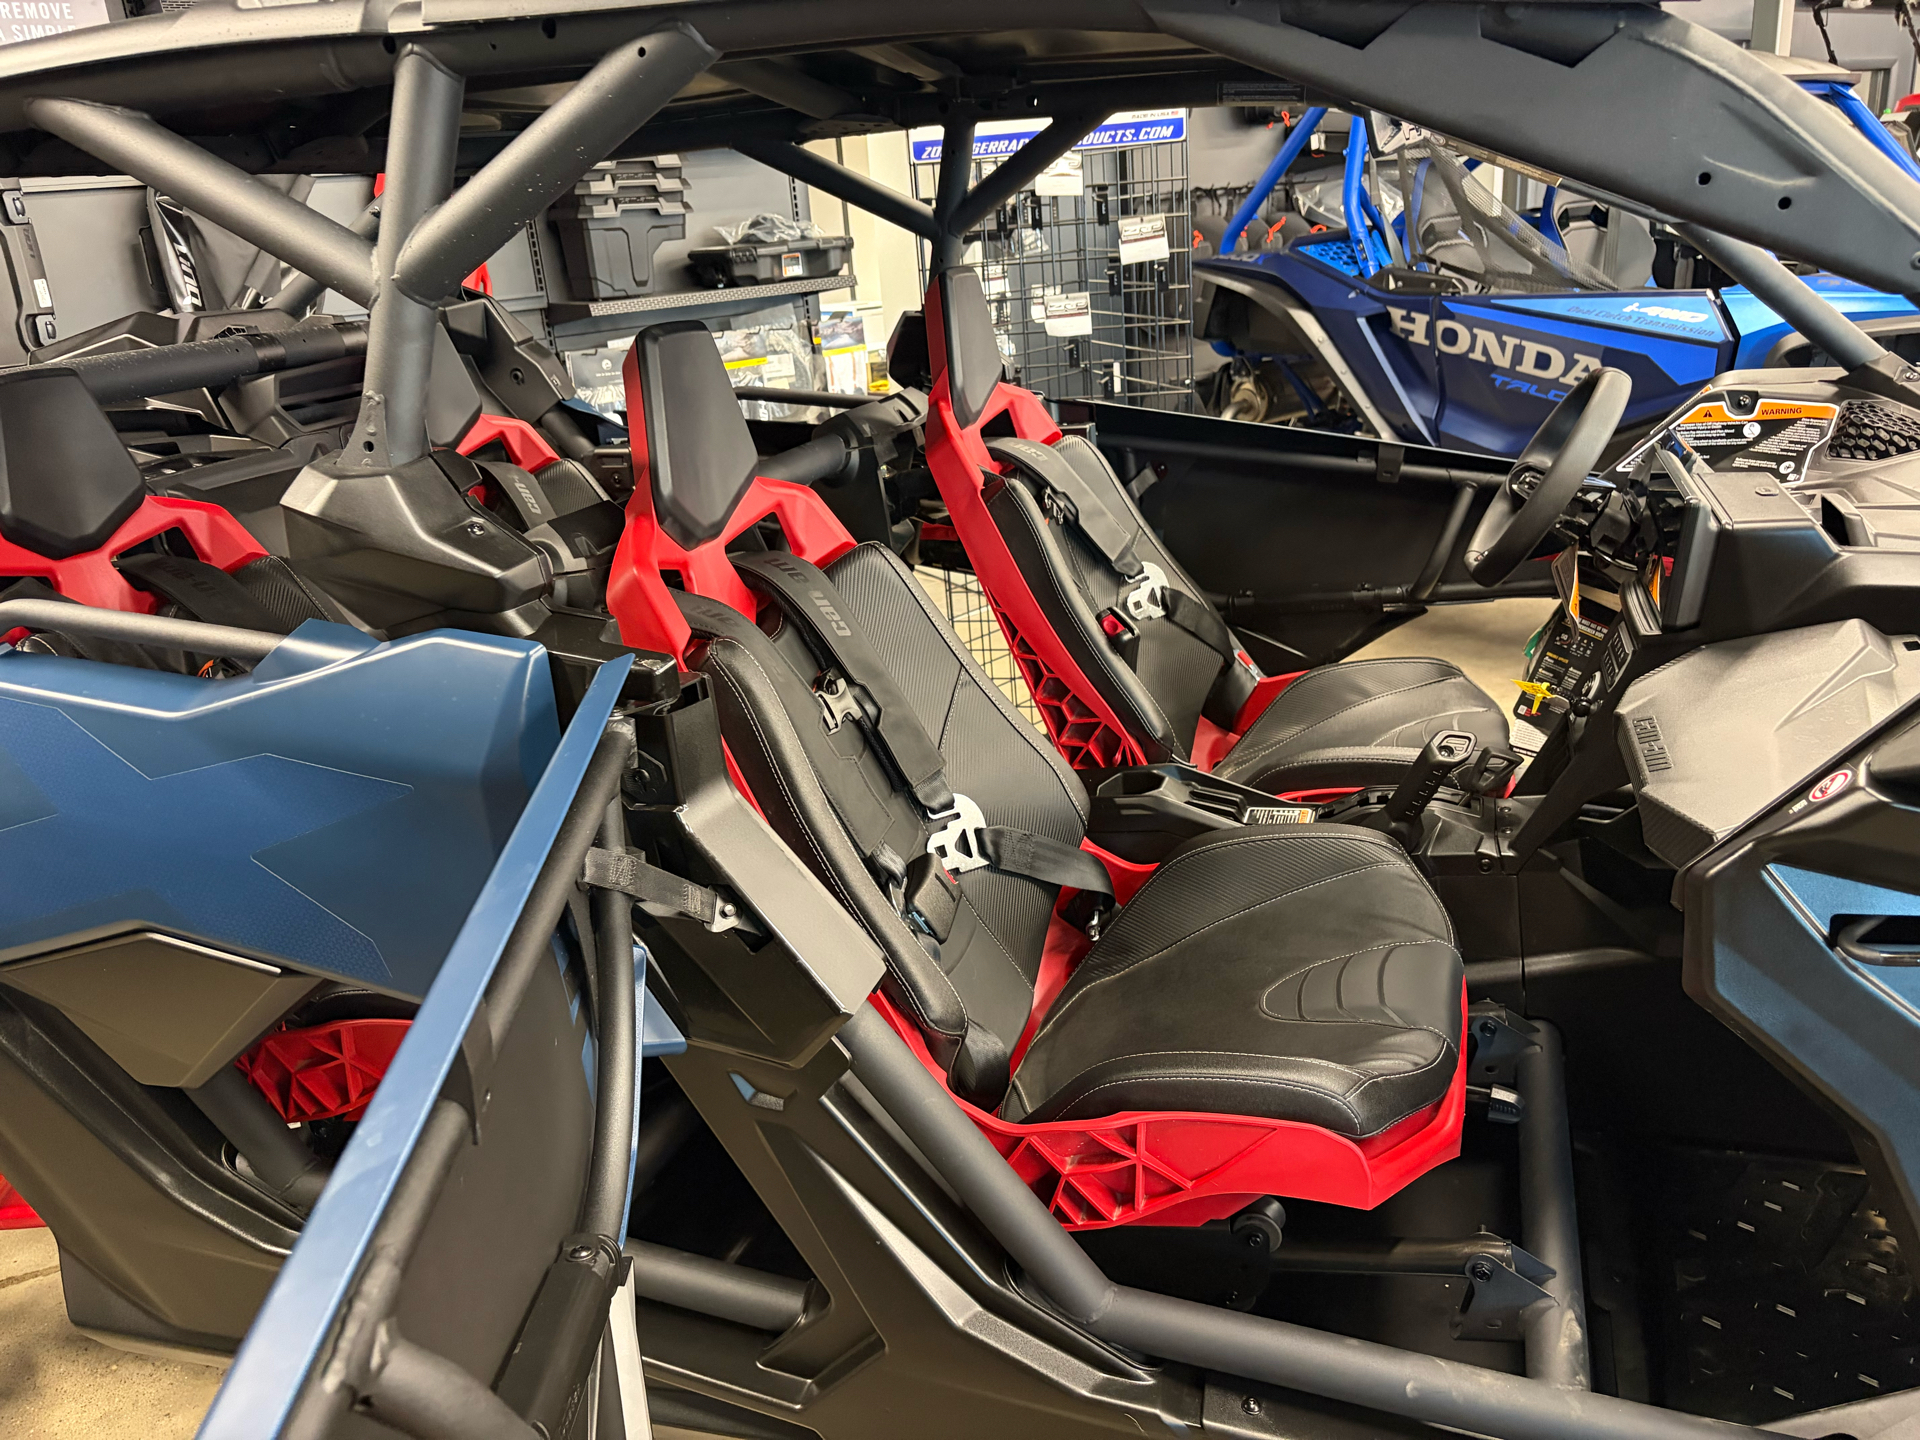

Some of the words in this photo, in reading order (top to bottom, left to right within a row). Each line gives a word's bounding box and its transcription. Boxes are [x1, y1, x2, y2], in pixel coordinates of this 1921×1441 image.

[0, 1, 74, 20] REMOVE
[11, 24, 76, 42] SIMP
[1594, 309, 1633, 323] Clutch
[1632, 315, 1716, 338] Transmission
[1385, 305, 1603, 385] HONDA
[1489, 372, 1568, 403] TALO
[1761, 406, 1802, 416] WARNING
